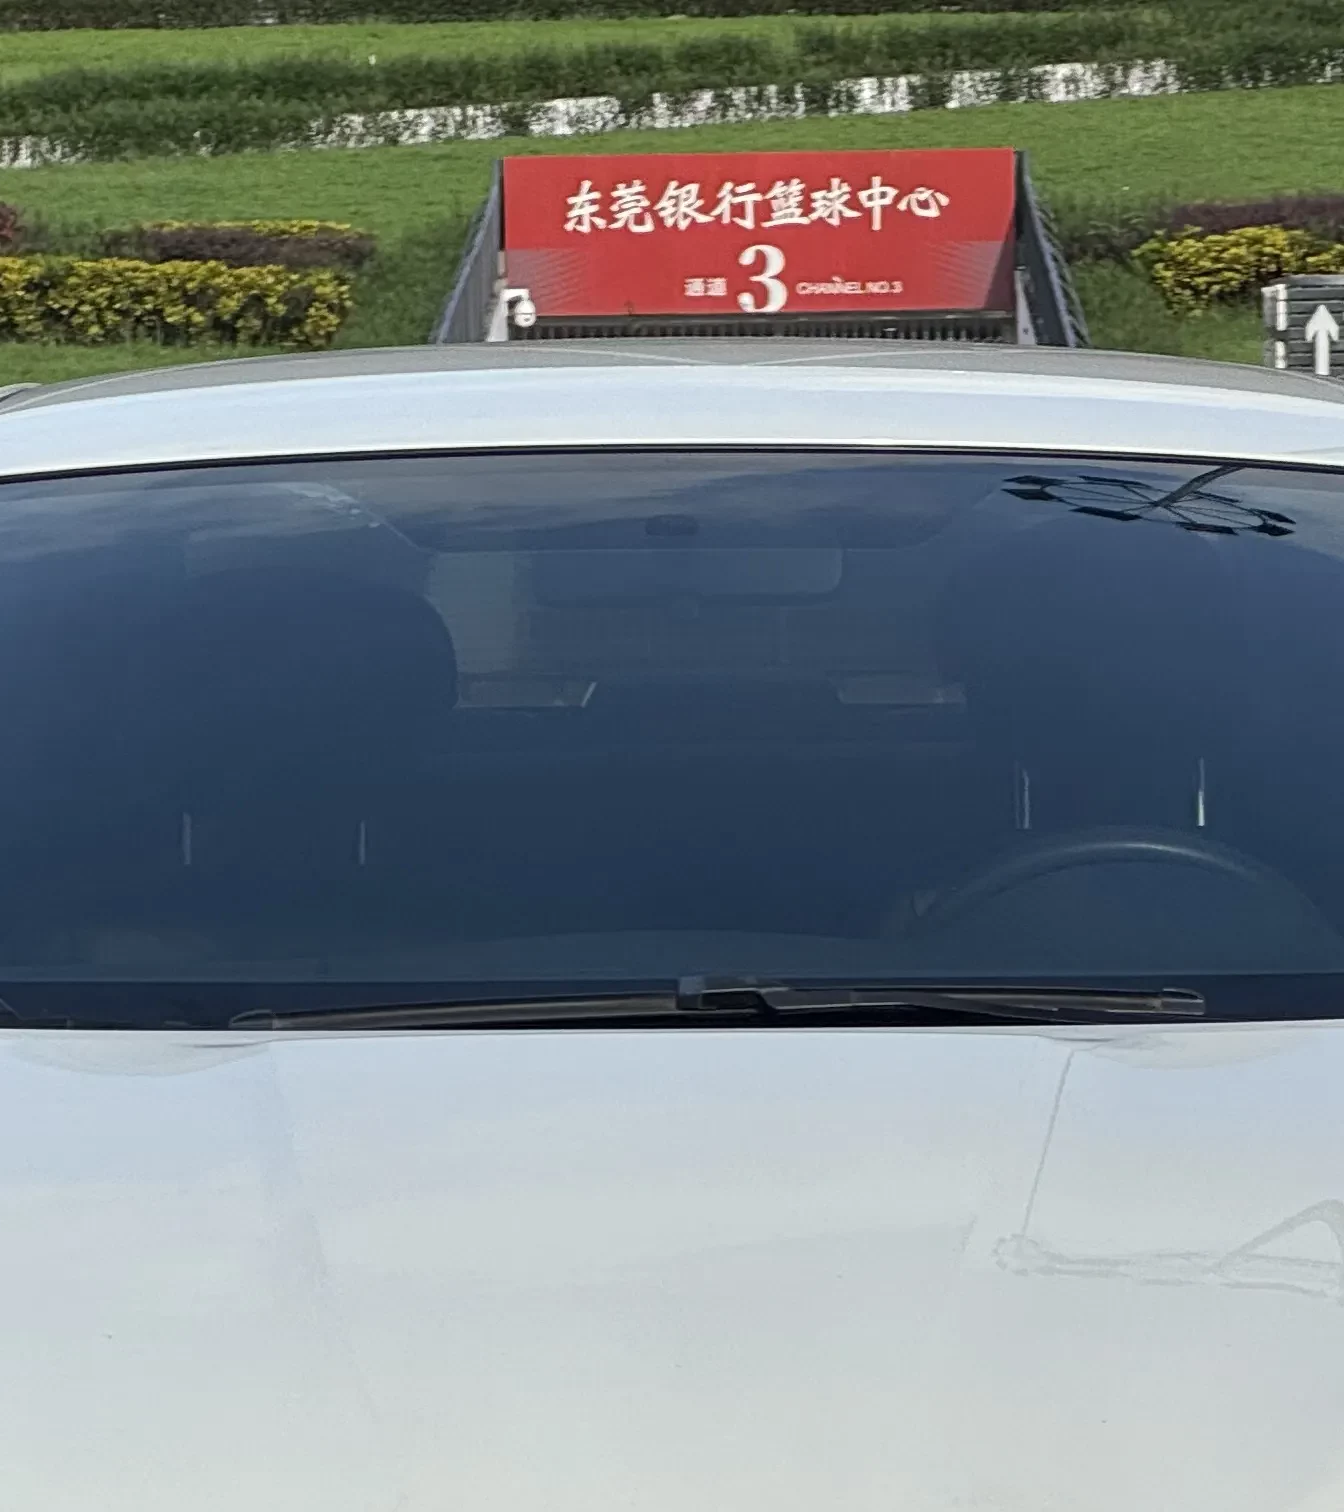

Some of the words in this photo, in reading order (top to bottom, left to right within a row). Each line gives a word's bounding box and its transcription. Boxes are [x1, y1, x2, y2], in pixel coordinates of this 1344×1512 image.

[563, 175, 950, 233] 东莞银行篮球中心
[737, 244, 788, 313] 3
